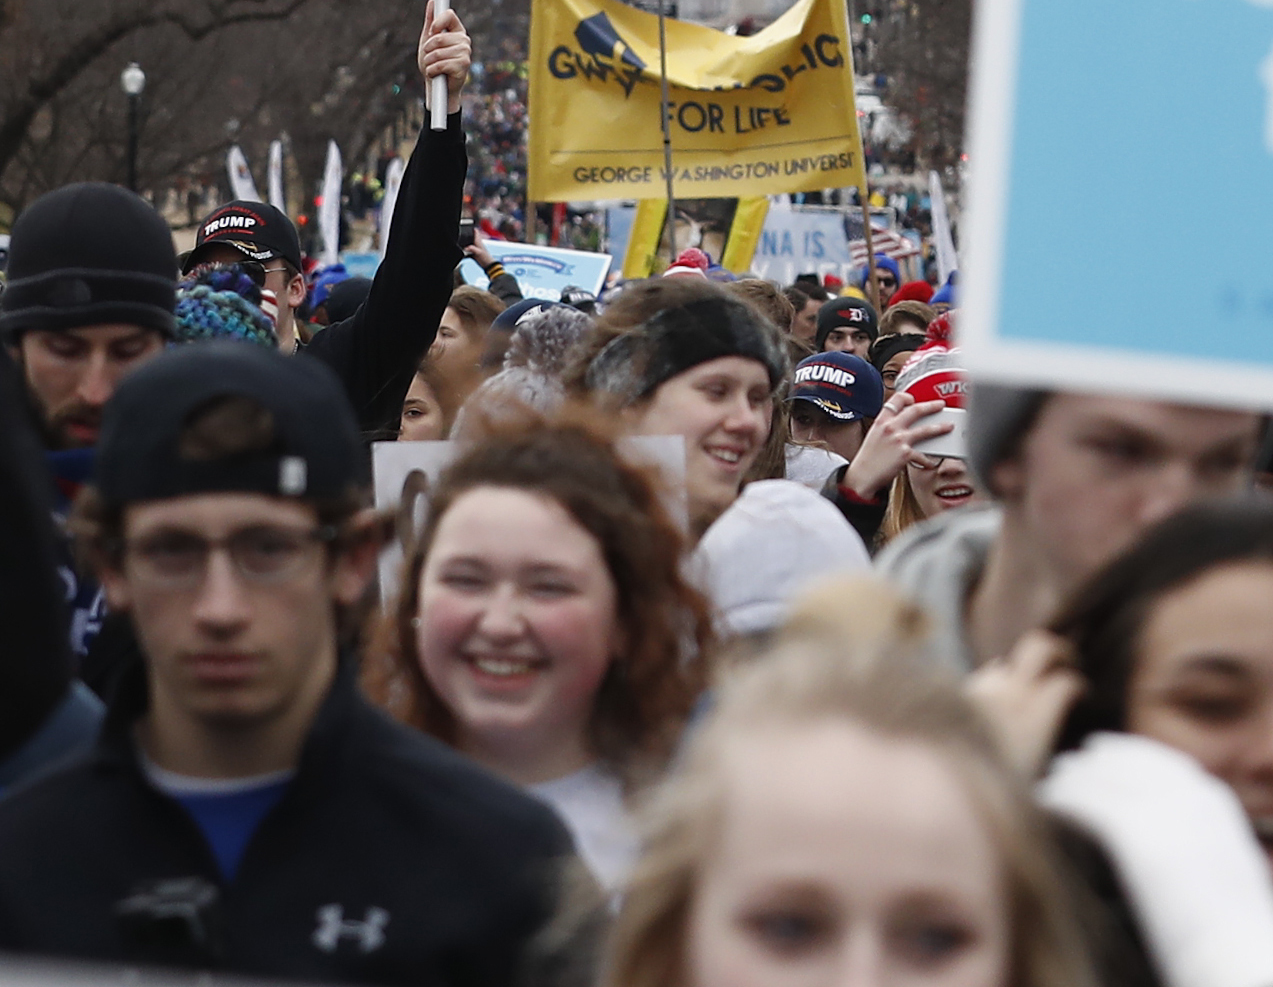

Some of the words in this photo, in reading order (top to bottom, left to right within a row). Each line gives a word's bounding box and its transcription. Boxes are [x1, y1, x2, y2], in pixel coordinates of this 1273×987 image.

[660, 101, 725, 133] FOR
[735, 104, 791, 134] LIFE
[573, 166, 652, 184] GEORGE
[660, 162, 780, 182] WASHINGTON
[784, 152, 854, 176] UNIVERSI
[204, 215, 256, 236] TRUMP
[794, 365, 856, 388] TRUMP
